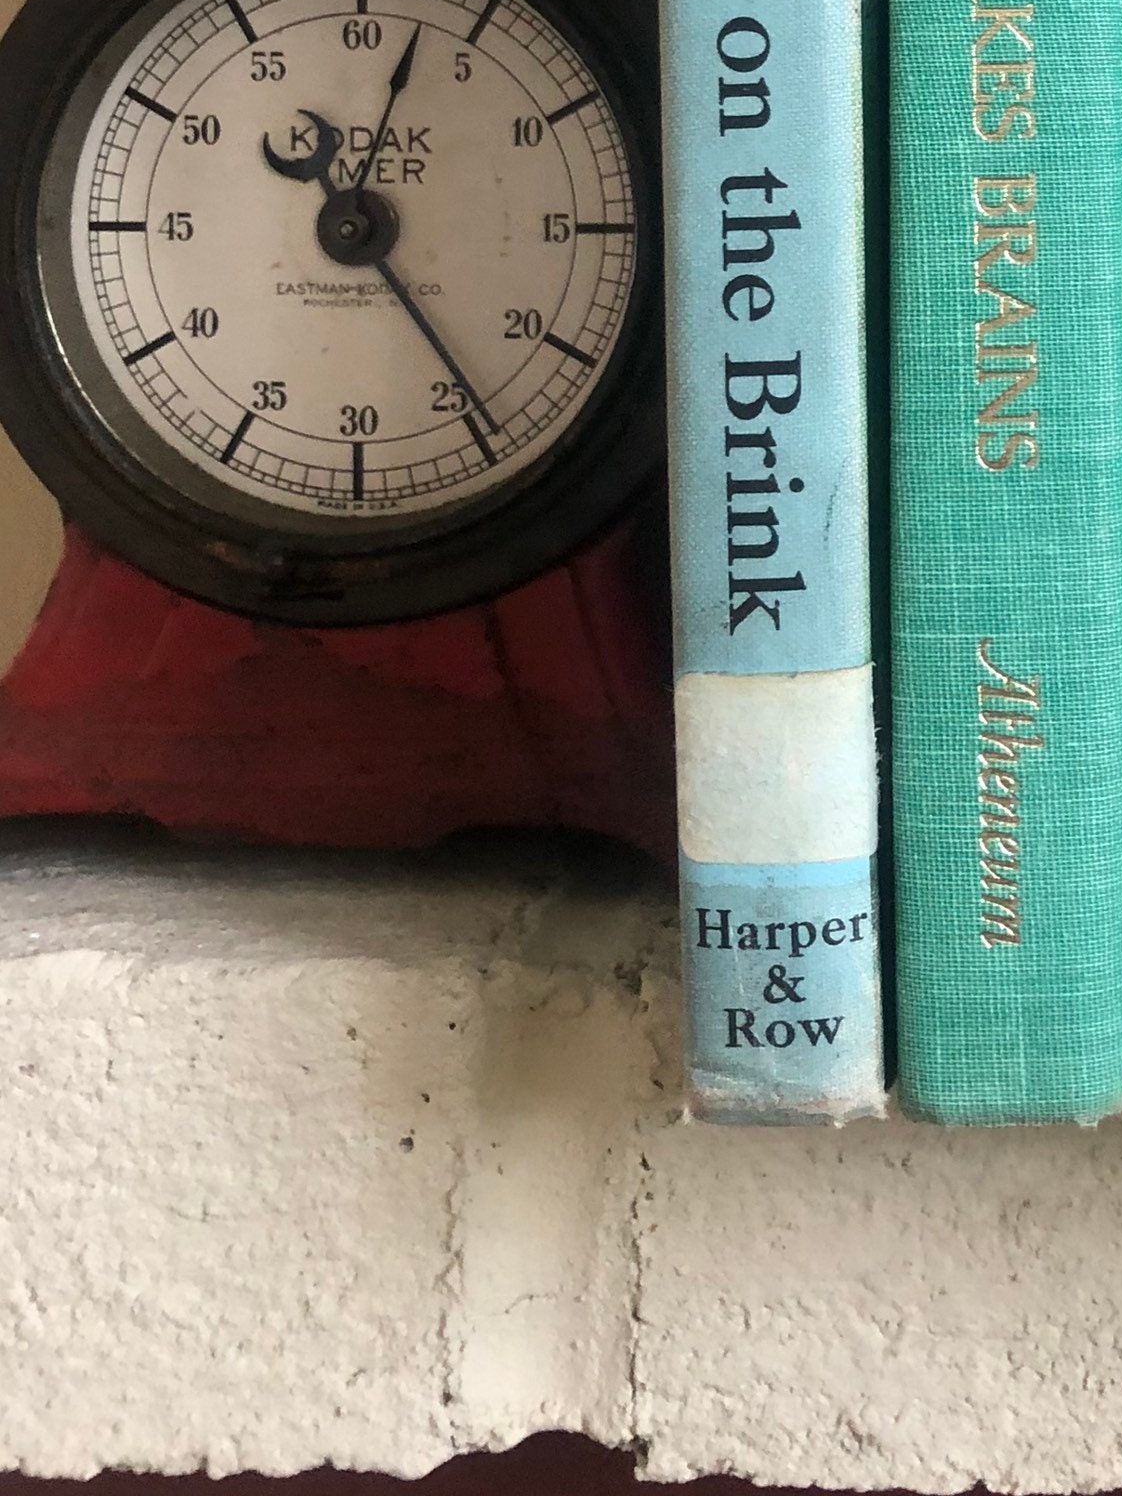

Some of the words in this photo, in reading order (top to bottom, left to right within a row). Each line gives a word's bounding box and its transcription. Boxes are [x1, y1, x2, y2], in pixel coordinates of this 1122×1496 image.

[342, 21, 382, 51] 60
[250, 52, 287, 83] 55
[453, 52, 472, 82] 5
[716, 16, 771, 137] on
[182, 116, 221, 146] 50
[512, 117, 543, 147] 10
[337, 158, 427, 185] MER
[158, 212, 194, 243] 45
[542, 213, 571, 243] 15
[720, 167, 802, 323] the
[181, 309, 219, 339] 40
[504, 310, 542, 340] 20
[973, 173, 1042, 473] BRAINS
[252, 381, 288, 411] 35
[431, 382, 469, 412] 25
[339, 406, 380, 437] 30
[723, 350, 808, 636] Brink
[976, 637, 1045, 951] Atheneum
[695, 908, 870, 960] Harper
[763, 965, 807, 1004] &
[724, 1008, 845, 1049] Row
